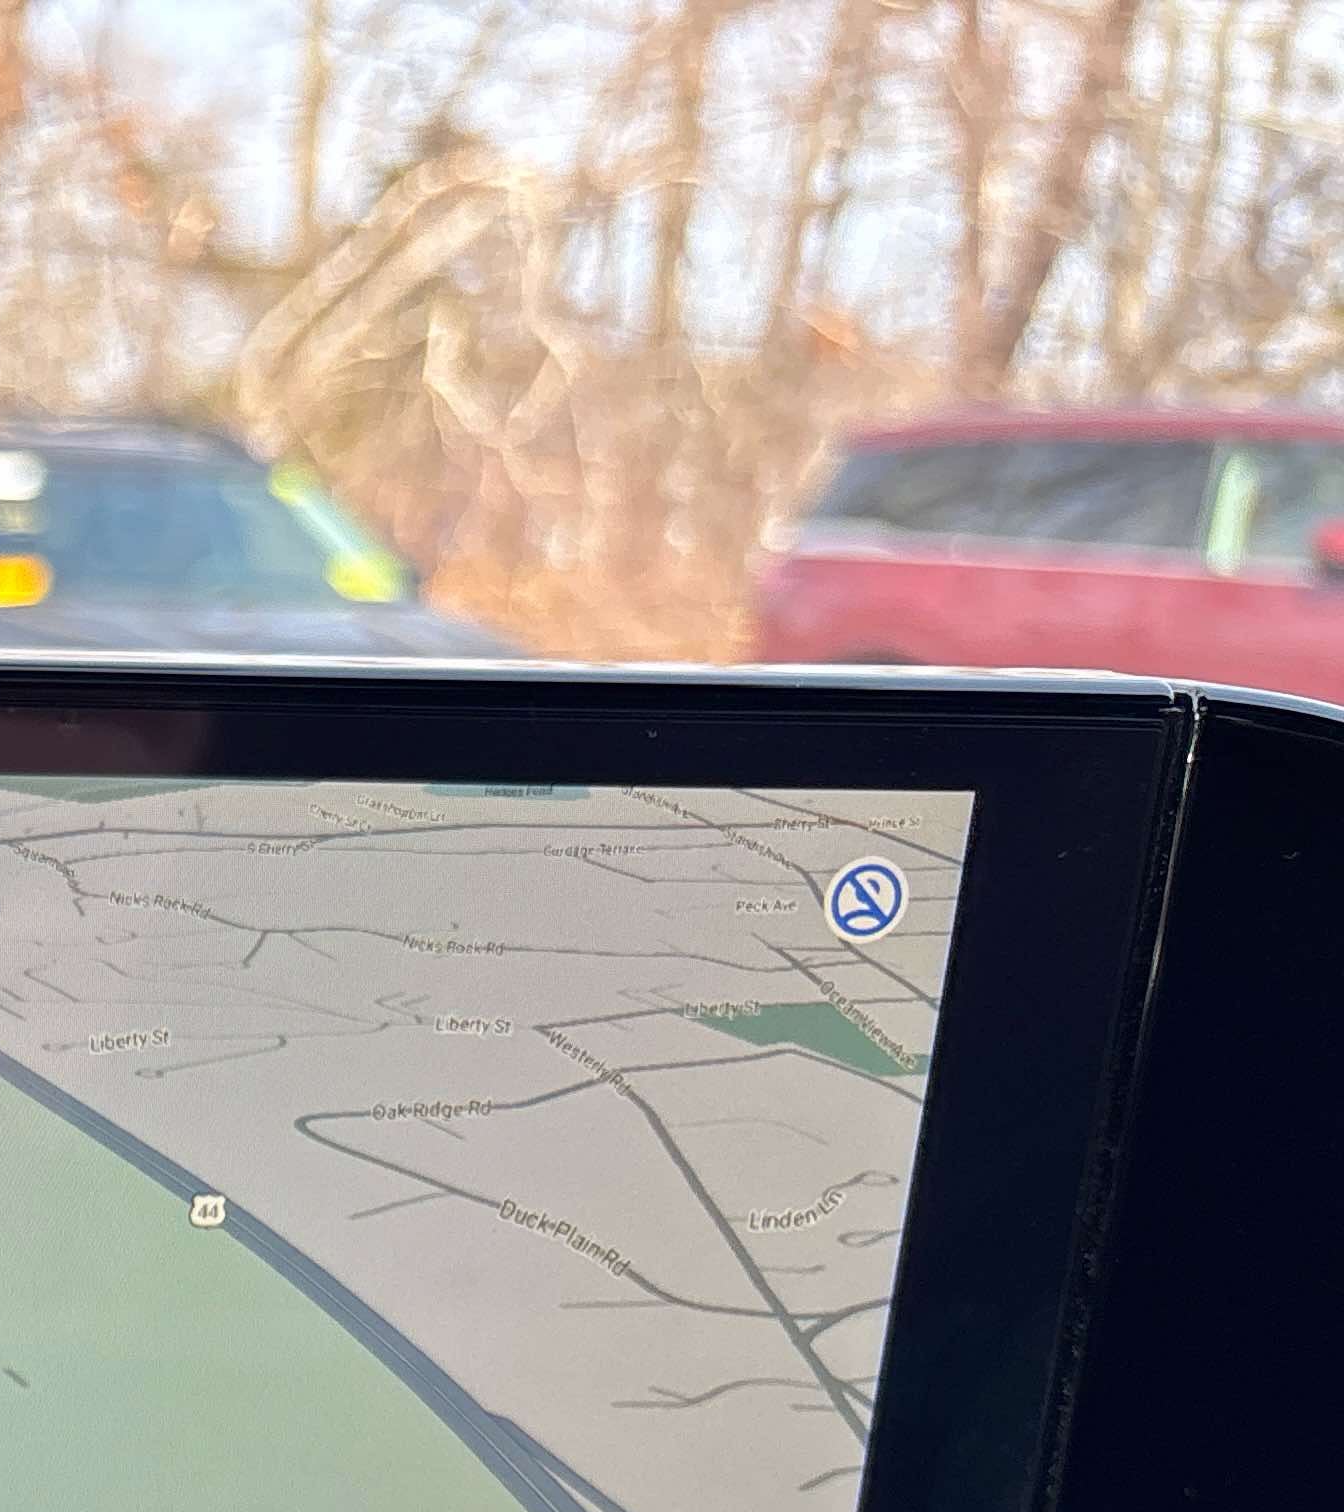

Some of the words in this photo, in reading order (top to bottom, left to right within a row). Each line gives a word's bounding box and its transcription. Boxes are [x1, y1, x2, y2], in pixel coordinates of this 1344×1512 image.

[434, 1015, 490, 1034] Liberty
[493, 1016, 513, 1033] St
[89, 1031, 148, 1053] Liberty
[151, 1029, 170, 1045] St
[548, 1028, 614, 1085] Westerly
[372, 1104, 410, 1121] Oak
[413, 1101, 464, 1121] Ridge
[469, 1100, 493, 1116] Rd
[198, 1203, 220, 1218] 44
[748, 1204, 817, 1232] Linden
[816, 1190, 845, 1216] Ln
[499, 1196, 556, 1236] Duck
[550, 1218, 606, 1260] Plain
[600, 1246, 633, 1279] Rd
